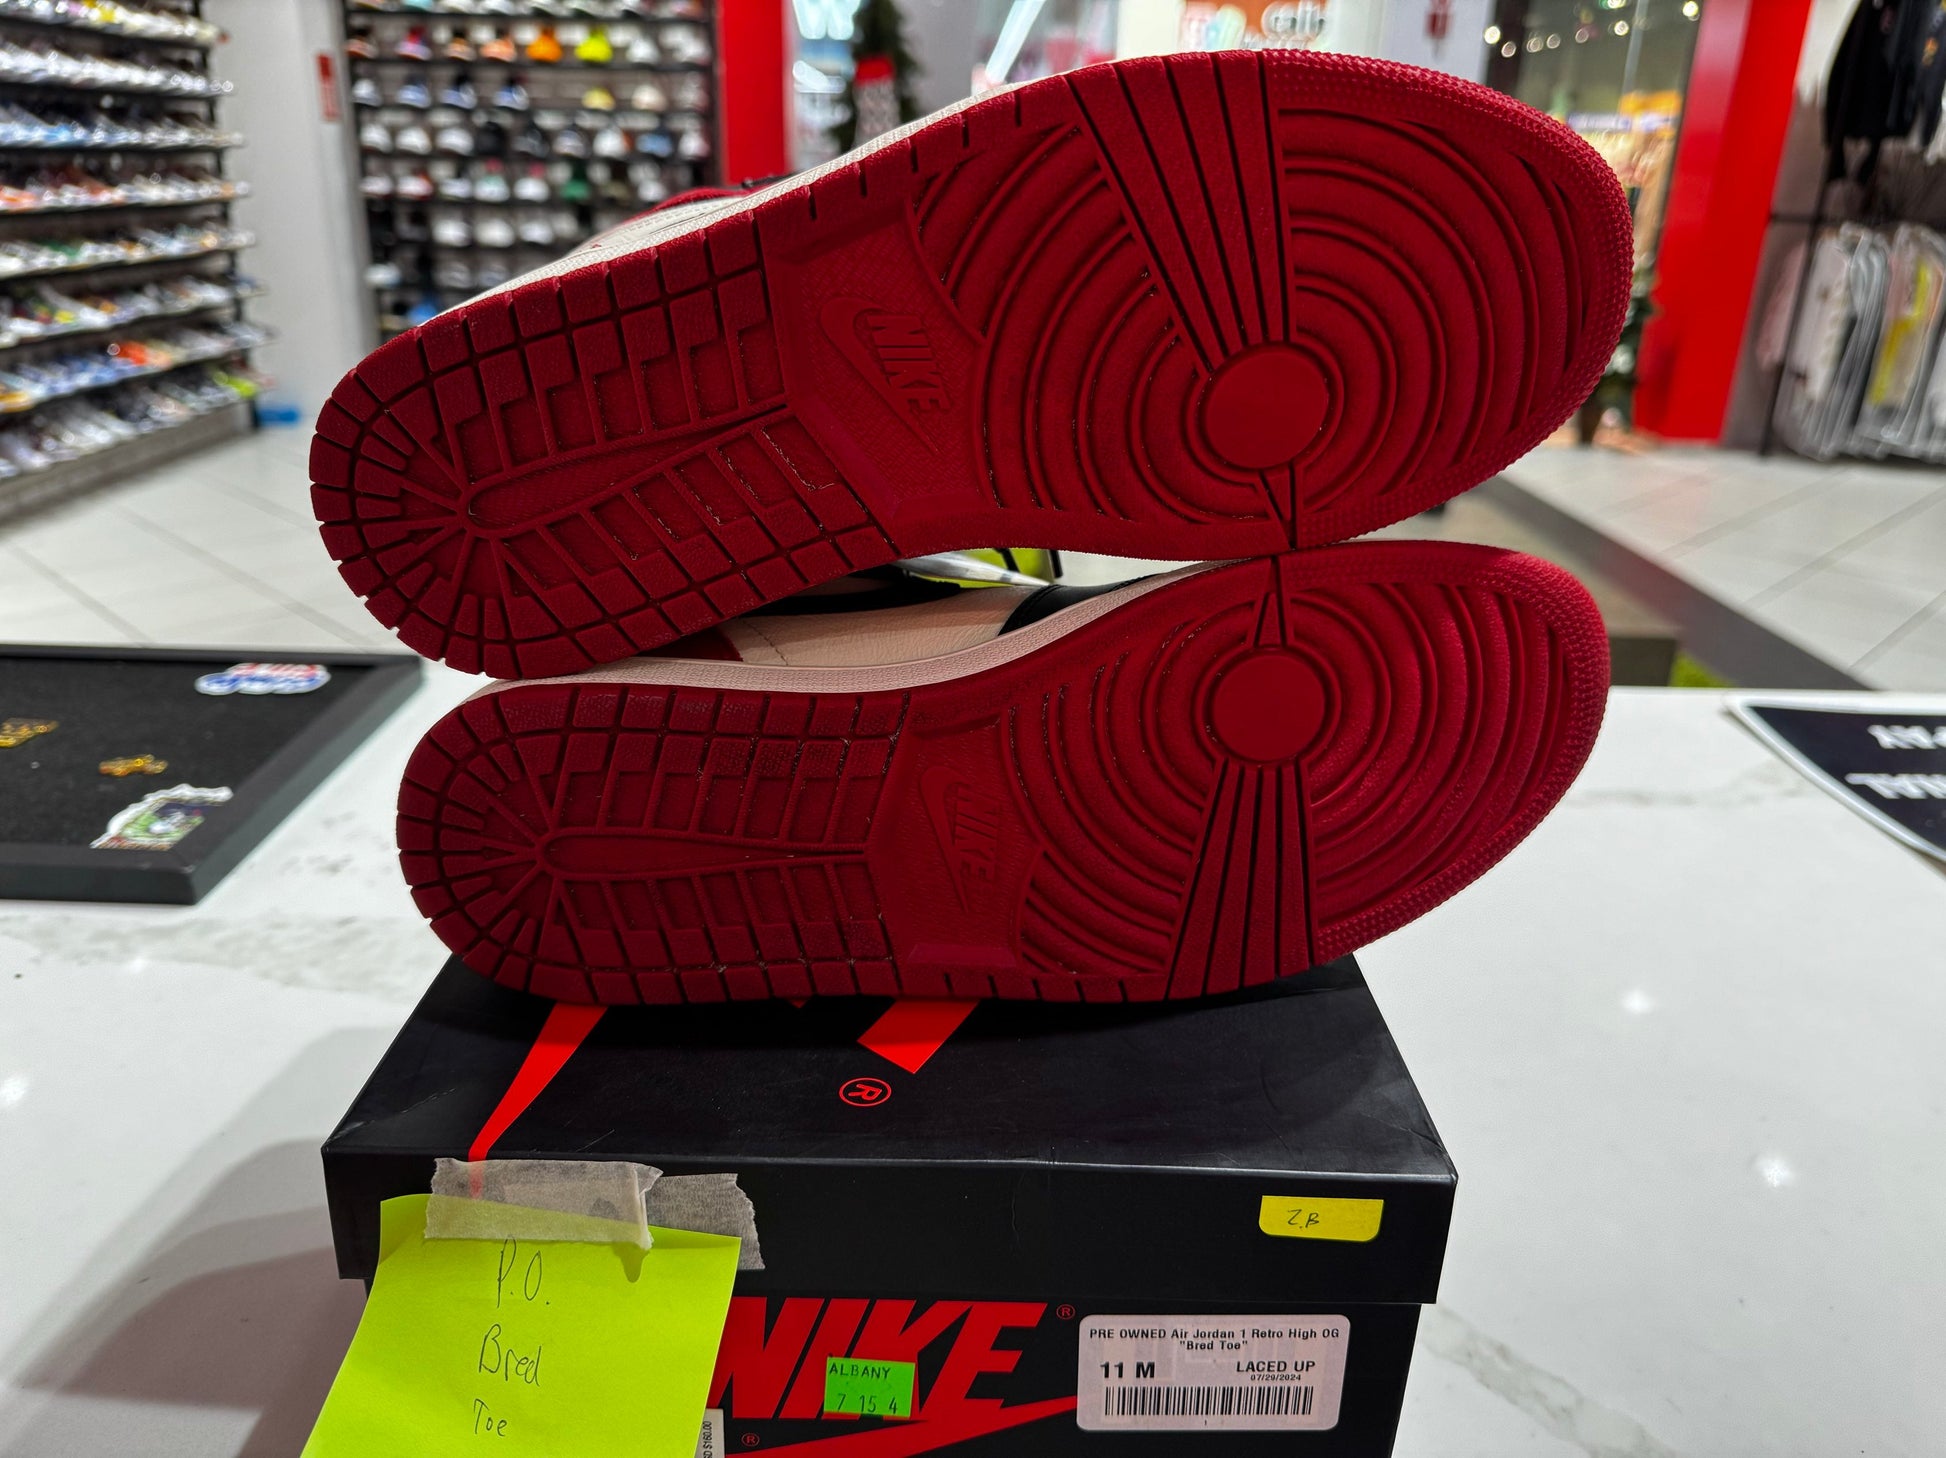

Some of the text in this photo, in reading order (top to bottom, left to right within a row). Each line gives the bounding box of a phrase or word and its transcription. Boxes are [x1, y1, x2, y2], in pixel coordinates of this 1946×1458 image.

[865, 313, 953, 415] NIKE
[955, 784, 1002, 883] NIKE
[1089, 1328, 1340, 1341] PRE OWNED Air Jordan 1 Retro High OG
[478, 1323, 543, 1387] Bred
[1179, 1340, 1248, 1351] "Bred Toe"
[703, 1296, 1048, 1420] NIKE
[1236, 1360, 1316, 1373] LACED UP
[829, 1362, 892, 1380] ALBANY
[1100, 1361, 1156, 1379] 11 M
[1250, 1373, 1302, 1382] 07/29/2024
[837, 1393, 898, 1415] 7 15 4
[473, 1398, 508, 1437] Toe
